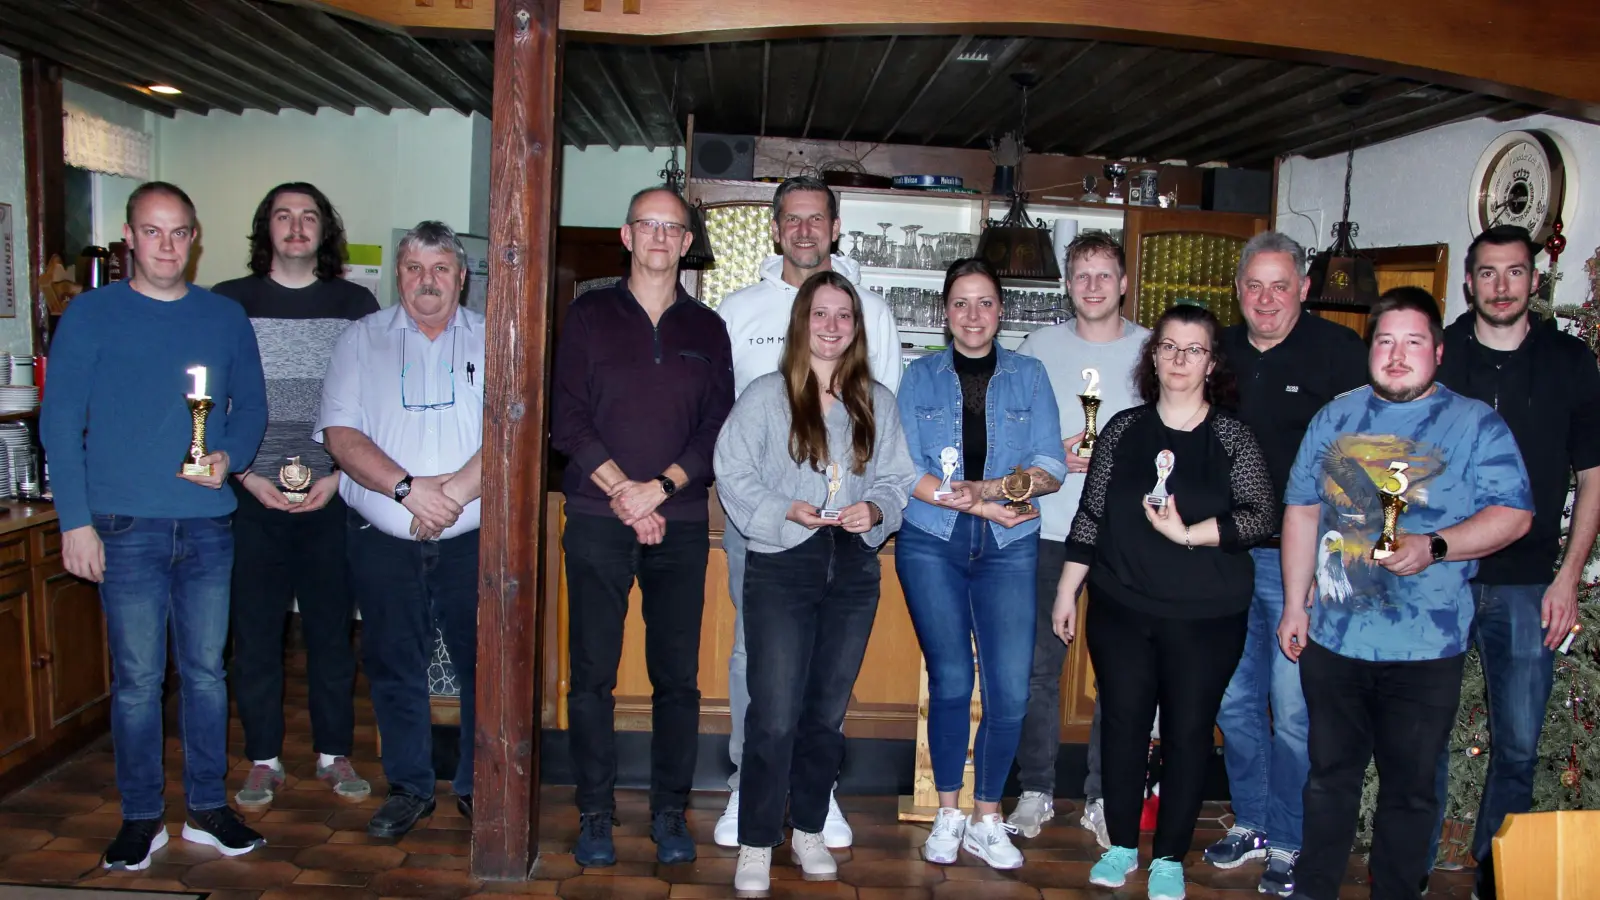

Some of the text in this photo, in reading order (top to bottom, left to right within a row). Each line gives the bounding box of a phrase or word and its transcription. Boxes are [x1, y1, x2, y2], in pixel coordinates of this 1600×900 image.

[4, 233, 13, 308] URKUNDE
[749, 336, 785, 345] TOMM
[186, 366, 212, 400] 1
[1082, 368, 1101, 397] 2
[1381, 461, 1409, 496] 3
